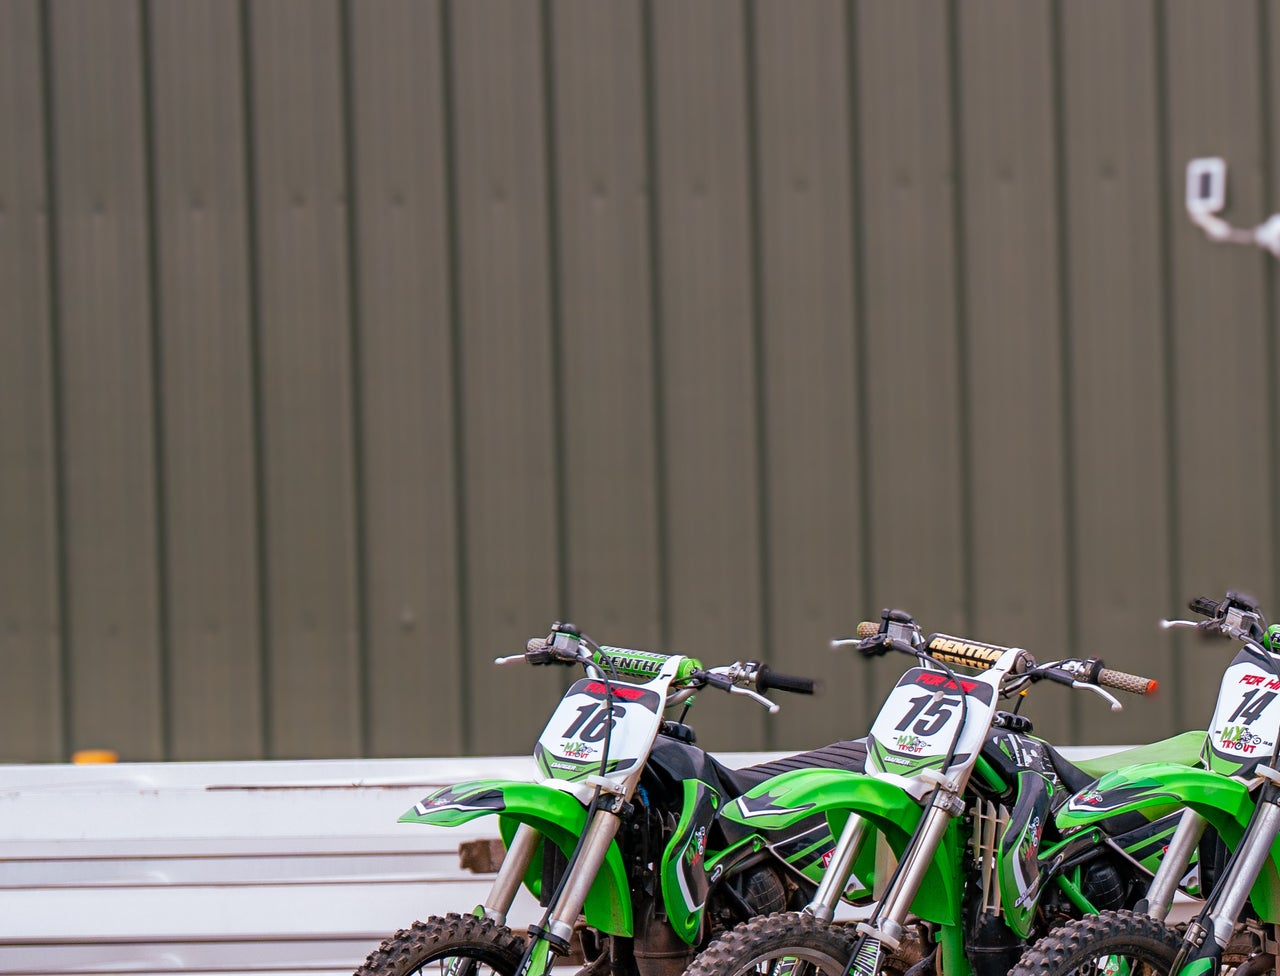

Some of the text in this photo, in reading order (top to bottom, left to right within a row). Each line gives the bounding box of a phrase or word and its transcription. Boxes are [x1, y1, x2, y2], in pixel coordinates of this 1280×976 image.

[598, 656, 665, 674] RENTHA
[929, 637, 1005, 662] RENTHA
[1239, 674, 1266, 687] FOR
[562, 702, 626, 742] 16
[894, 694, 961, 737] 15
[1228, 688, 1278, 726] 14
